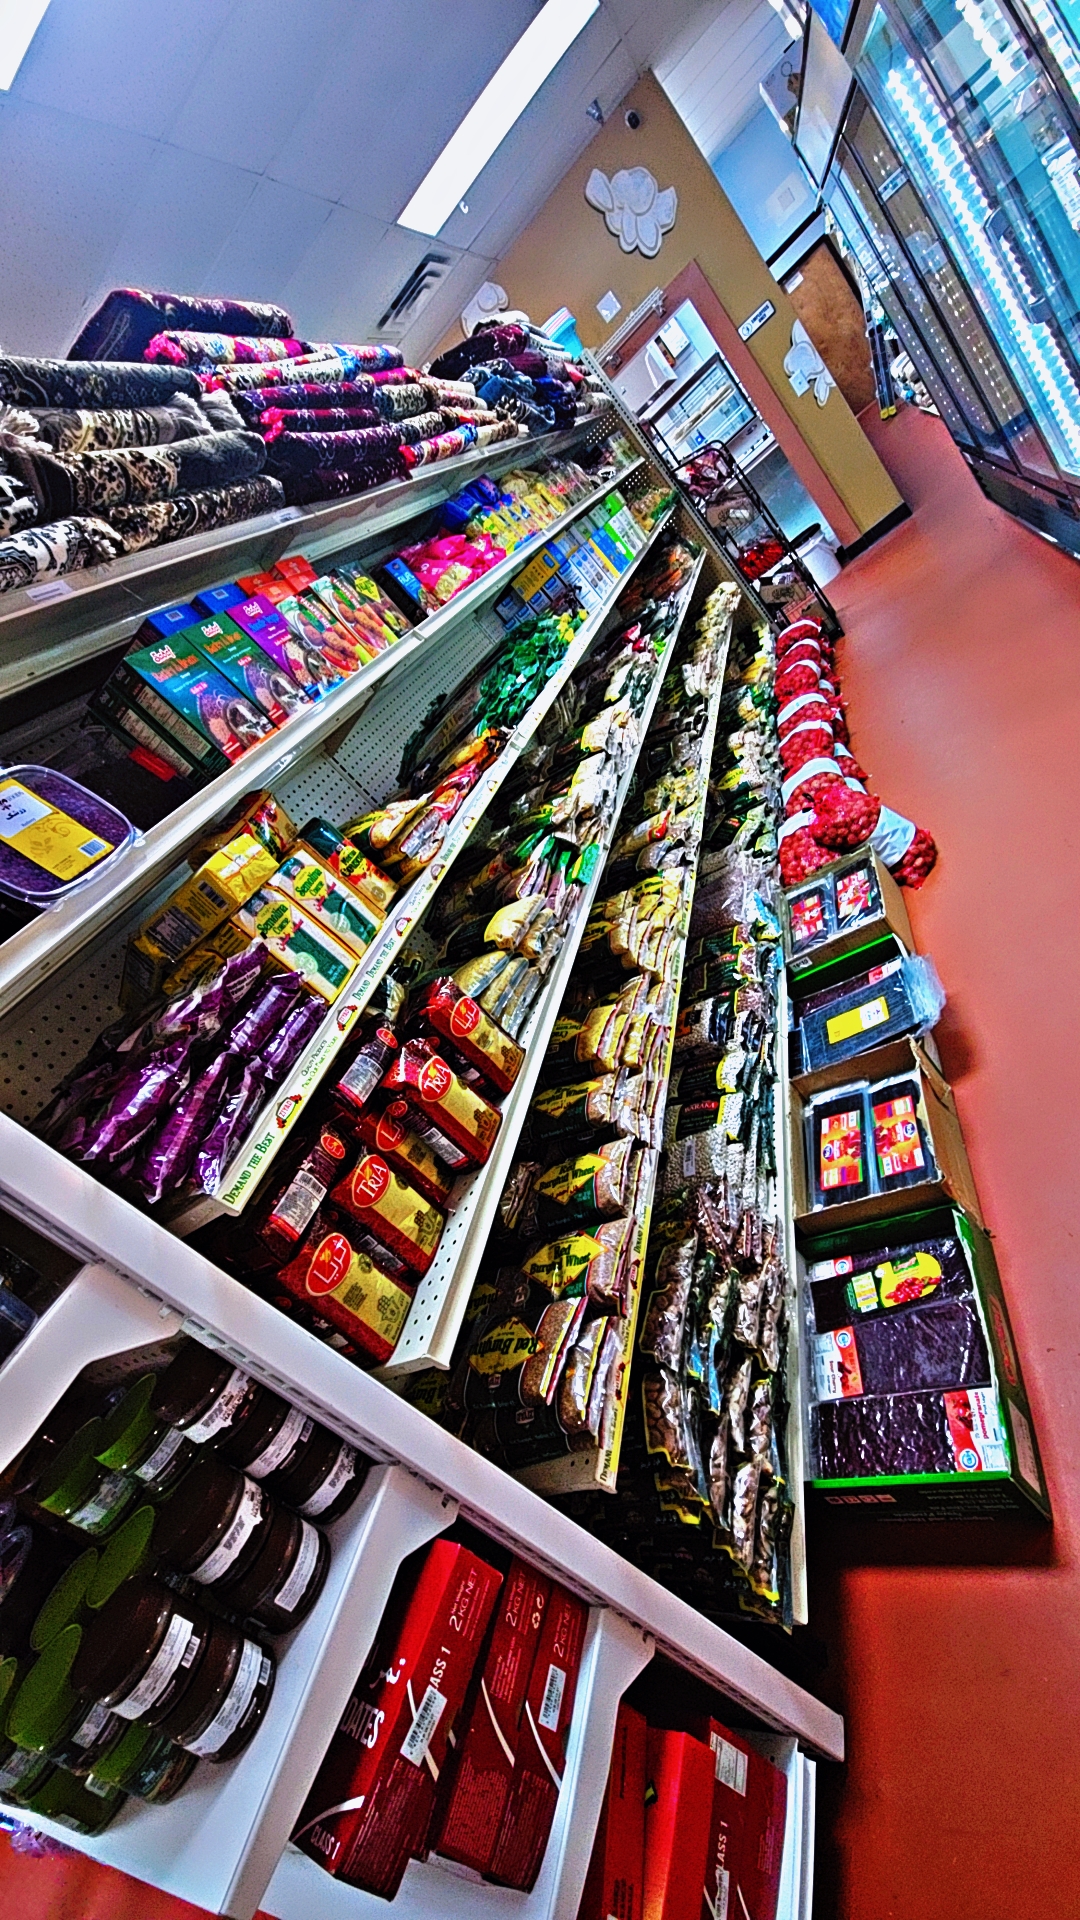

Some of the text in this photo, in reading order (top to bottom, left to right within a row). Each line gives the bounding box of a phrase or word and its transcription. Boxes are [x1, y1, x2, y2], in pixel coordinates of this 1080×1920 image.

[299, 597, 321, 618] FALAFEL
[295, 868, 322, 897] Semolina
[309, 881, 324, 897] Coarse
[257, 904, 289, 935] Semolina
[272, 918, 289, 935] Coarse
[424, 1063, 451, 1094] TRIA
[279, 1100, 293, 1118] ZIYAD
[356, 1163, 387, 1198] TRIA
[571, 1165, 596, 1178] Wheat
[553, 1244, 572, 1260] Red
[566, 1251, 592, 1267] Wheat
[513, 1336, 538, 1354] Red
[974, 1391, 990, 1440] pomegranate
[449, 1615, 463, 1632] 2
[466, 1568, 478, 1595] NET
[505, 1612, 517, 1627] 2
[553, 1643, 564, 1658] 2
[429, 1646, 451, 1690] ASS 1
[340, 1696, 385, 1749] DATES
[311, 1825, 340, 1860] CLASS 1
[715, 1820, 729, 1874] LASS 1
